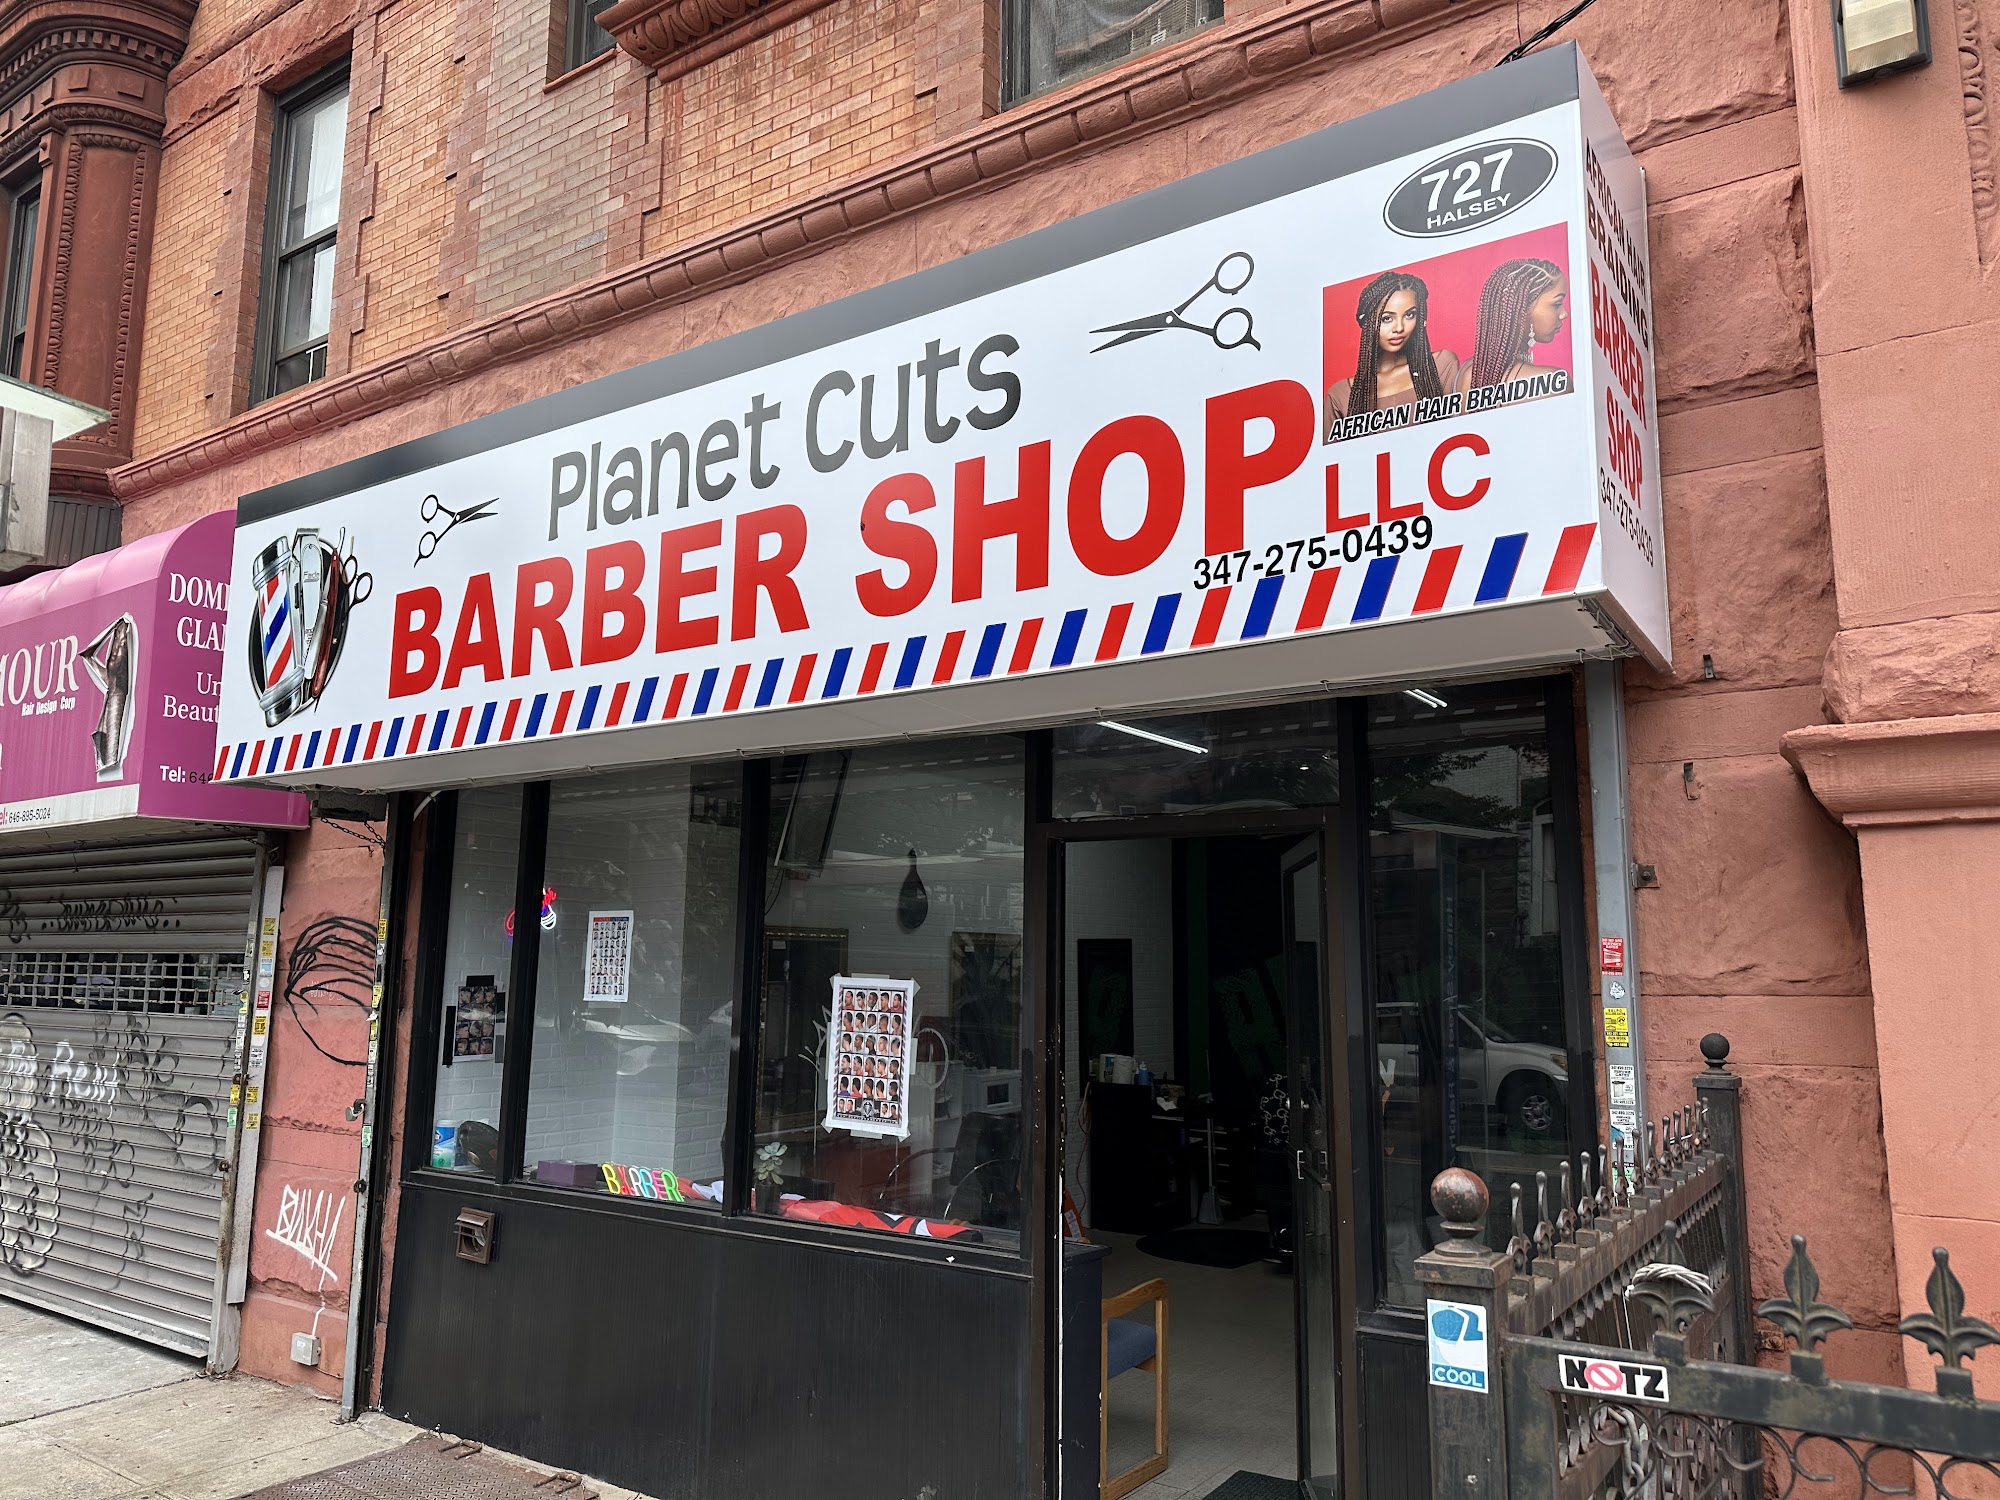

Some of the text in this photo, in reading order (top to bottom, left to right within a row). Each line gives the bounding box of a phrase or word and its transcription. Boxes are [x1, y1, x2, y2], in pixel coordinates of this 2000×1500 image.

[1421, 148, 1513, 213] 727
[1426, 192, 1511, 230] HALSEY
[1585, 136, 1647, 303] AFRICAN HAIR
[1587, 188, 1649, 352] BRAIDING
[1590, 257, 1648, 430] BARBER
[1328, 370, 1568, 441] AFRICAN HAIR BRAIDING
[547, 393, 782, 541] Planet
[1606, 385, 1643, 510] SHOP
[388, 379, 1491, 699] BARBER SHOP LLC
[1193, 515, 1433, 590] 347-275-0439
[1600, 466, 1654, 568] 347-275-0439
[21, 695, 76, 716] Hair Design Corp
[159, 765, 186, 783] Tel:
[601, 1162, 685, 1202] BARBER
[1434, 1366, 1483, 1388] COOL
